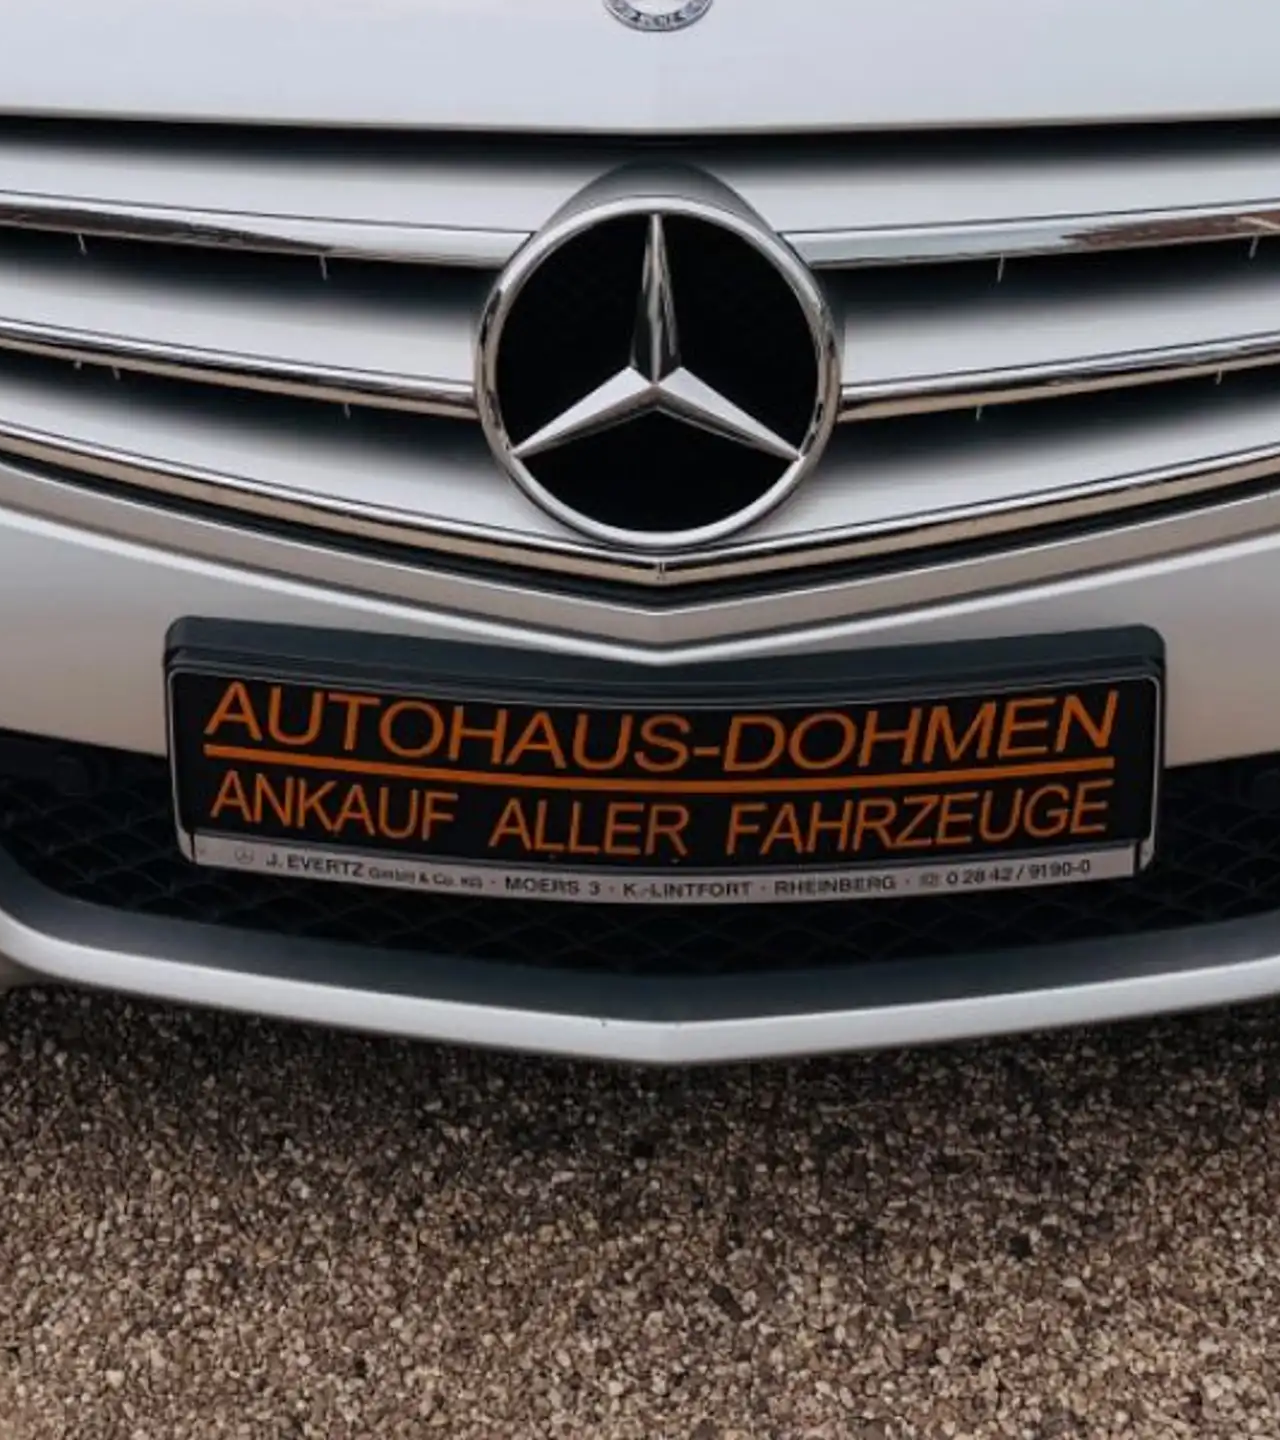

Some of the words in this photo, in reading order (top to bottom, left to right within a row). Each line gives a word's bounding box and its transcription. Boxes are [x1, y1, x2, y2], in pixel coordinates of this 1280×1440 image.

[203, 680, 1119, 773] AUTOHAUS-DOHMEN
[210, 769, 459, 841] ANKAUF
[487, 799, 690, 857] ALLER
[726, 778, 1114, 856] FAHRZEUGE
[286, 853, 365, 878] EVERTZ
[417, 872, 431, 886] &
[504, 875, 581, 896] MOERS
[588, 880, 602, 896] 3
[773, 874, 898, 895] RHEINBERG
